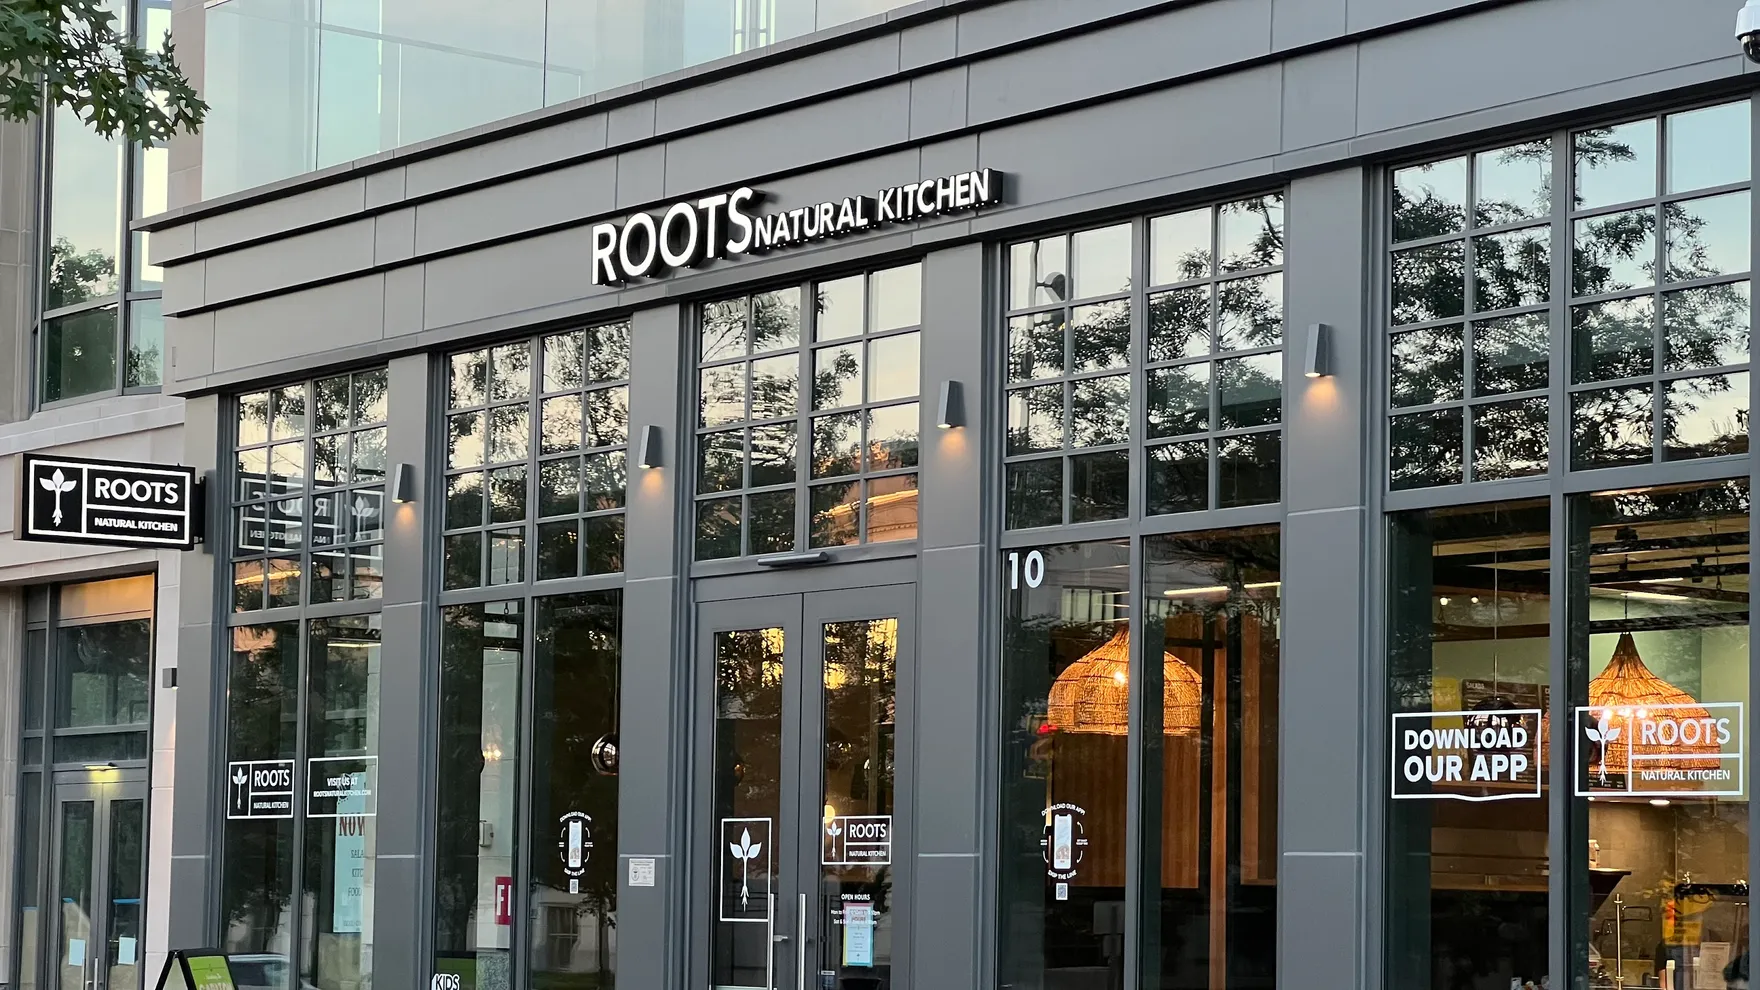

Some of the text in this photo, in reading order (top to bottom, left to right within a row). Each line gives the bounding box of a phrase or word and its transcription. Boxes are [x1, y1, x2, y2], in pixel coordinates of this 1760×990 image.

[592, 168, 989, 285] ROOTS NATURAL KITCHEN
[95, 477, 178, 504] ROOTS
[95, 517, 178, 532] NATURAL KITCHEN
[1009, 550, 1044, 589] 10
[1404, 727, 1528, 750] DOWNLOAD
[1641, 717, 1731, 746] ROOTS
[1404, 754, 1528, 782] OUR APP
[1641, 769, 1730, 781] NATURAL KITCHEN
[254, 769, 290, 787] ROOTS
[327, 776, 358, 787] VISIT US AT
[272, 801, 289, 809] KITCHEN
[849, 823, 887, 838] ROOTS
[854, 893, 871, 901] HOURS
[436, 974, 460, 990] KIDS
